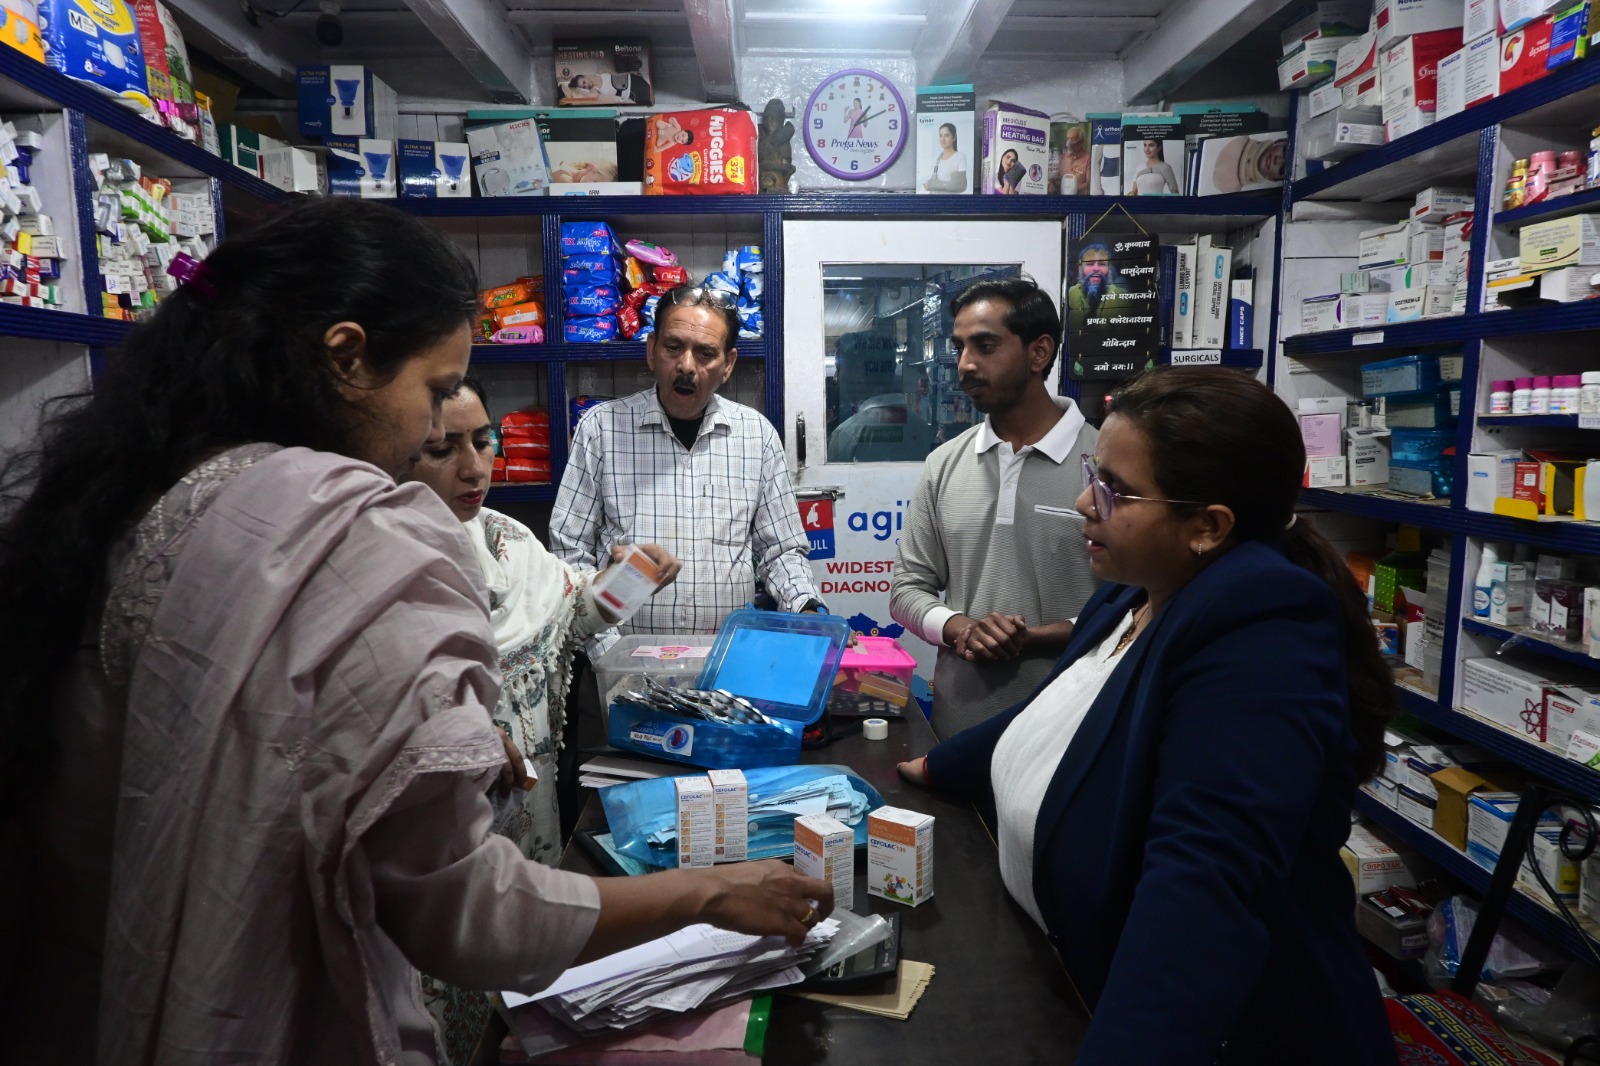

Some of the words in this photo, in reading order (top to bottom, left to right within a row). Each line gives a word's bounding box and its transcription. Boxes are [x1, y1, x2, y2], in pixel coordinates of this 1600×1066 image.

[1529, 42, 1550, 57] mecip
[814, 103, 828, 112] 10
[887, 104, 895, 112] 2
[814, 118, 823, 130] 9
[888, 119, 898, 130] 3
[817, 139, 826, 148] 8
[1002, 132, 1031, 142] HEATING
[1031, 135, 1045, 144] BAG
[709, 115, 725, 184] HUGGIES
[831, 138, 854, 151] Prega
[855, 138, 879, 149] News
[887, 140, 893, 148] 4
[832, 157, 838, 165] 7
[874, 155, 881, 164] 5
[850, 160, 858, 171] 6
[1113, 242, 1124, 252] ॐ
[1120, 265, 1155, 277] वासुदेवाय
[1102, 338, 1136, 348] गोविन्दाय
[1174, 354, 1219, 363] SURGICALS
[848, 500, 910, 541] agi
[808, 538, 828, 550] ULL
[826, 561, 894, 575] WIDEST
[821, 580, 891, 594] DIAGNO
[825, 837, 845, 846] CEFOLAC
[870, 838, 896, 850] CEFOLAC
[795, 844, 811, 858] CEFOLAC
